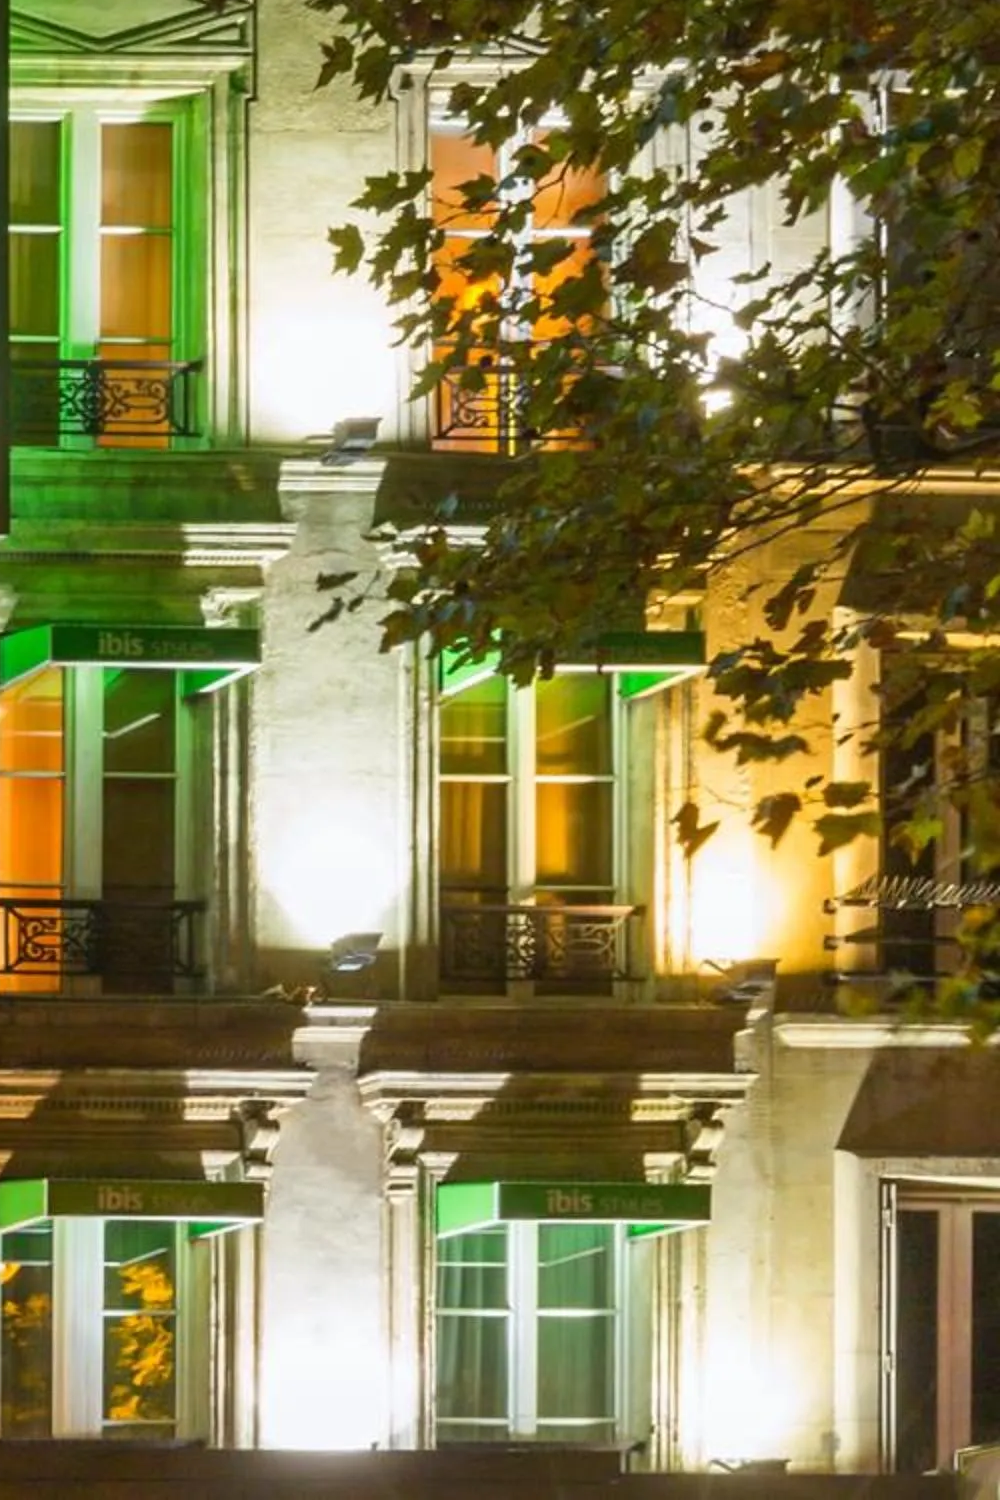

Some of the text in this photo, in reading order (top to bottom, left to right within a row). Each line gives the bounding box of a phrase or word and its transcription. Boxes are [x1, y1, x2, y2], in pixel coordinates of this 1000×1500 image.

[98, 631, 144, 656] ibis
[98, 1186, 144, 1210] ibis
[547, 1189, 592, 1213] ibis
